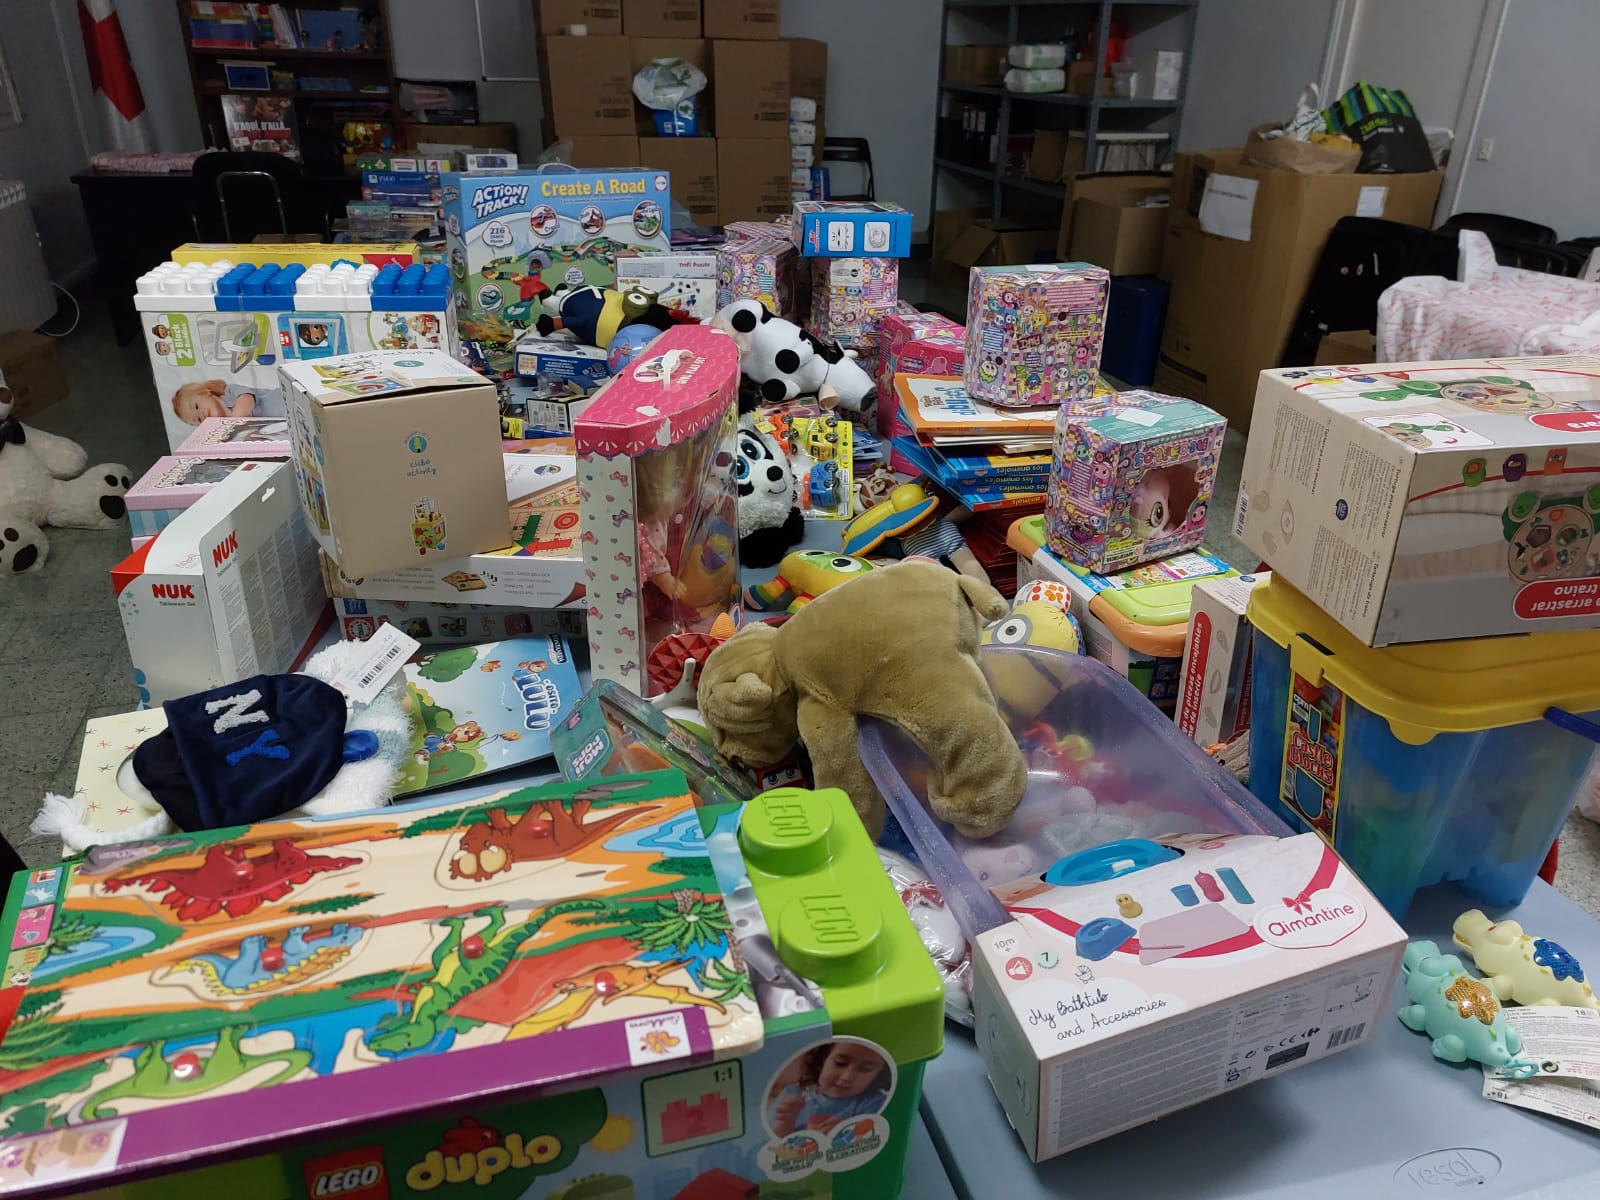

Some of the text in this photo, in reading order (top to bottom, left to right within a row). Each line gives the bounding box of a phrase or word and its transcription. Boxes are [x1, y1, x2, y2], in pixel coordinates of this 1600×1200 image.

[541, 178, 646, 197] Create A Road
[489, 226, 506, 235] 216
[176, 348, 193, 360] 2
[406, 467, 437, 478] activity
[409, 459, 431, 468] cubo
[996, 465, 1031, 475] animales
[985, 475, 1025, 484] animales
[998, 484, 1035, 493] animales
[212, 529, 239, 569] NUK
[151, 583, 195, 599] NUK
[1553, 582, 1600, 597] traino
[1530, 597, 1595, 612] arrastrar
[1190, 621, 1204, 675] encajables
[1186, 676, 1197, 707] piezas
[1192, 673, 1202, 711] inserire
[1184, 708, 1191, 721] de
[571, 734, 601, 767] POPS
[1293, 731, 1333, 768] Castle
[1291, 745, 1333, 785] Blocks
[761, 794, 814, 838] LEGO
[799, 894, 862, 944] LEGO
[1268, 905, 1355, 936] aimantine
[993, 936, 1016, 950] 10m
[1040, 951, 1049, 962] 7
[1029, 988, 1109, 1029] My Bathtub
[1057, 999, 1167, 1041] and Accessories
[713, 1067, 734, 1083] 1:1
[405, 1132, 562, 1191] duplo
[315, 1165, 380, 1197] LEGO
